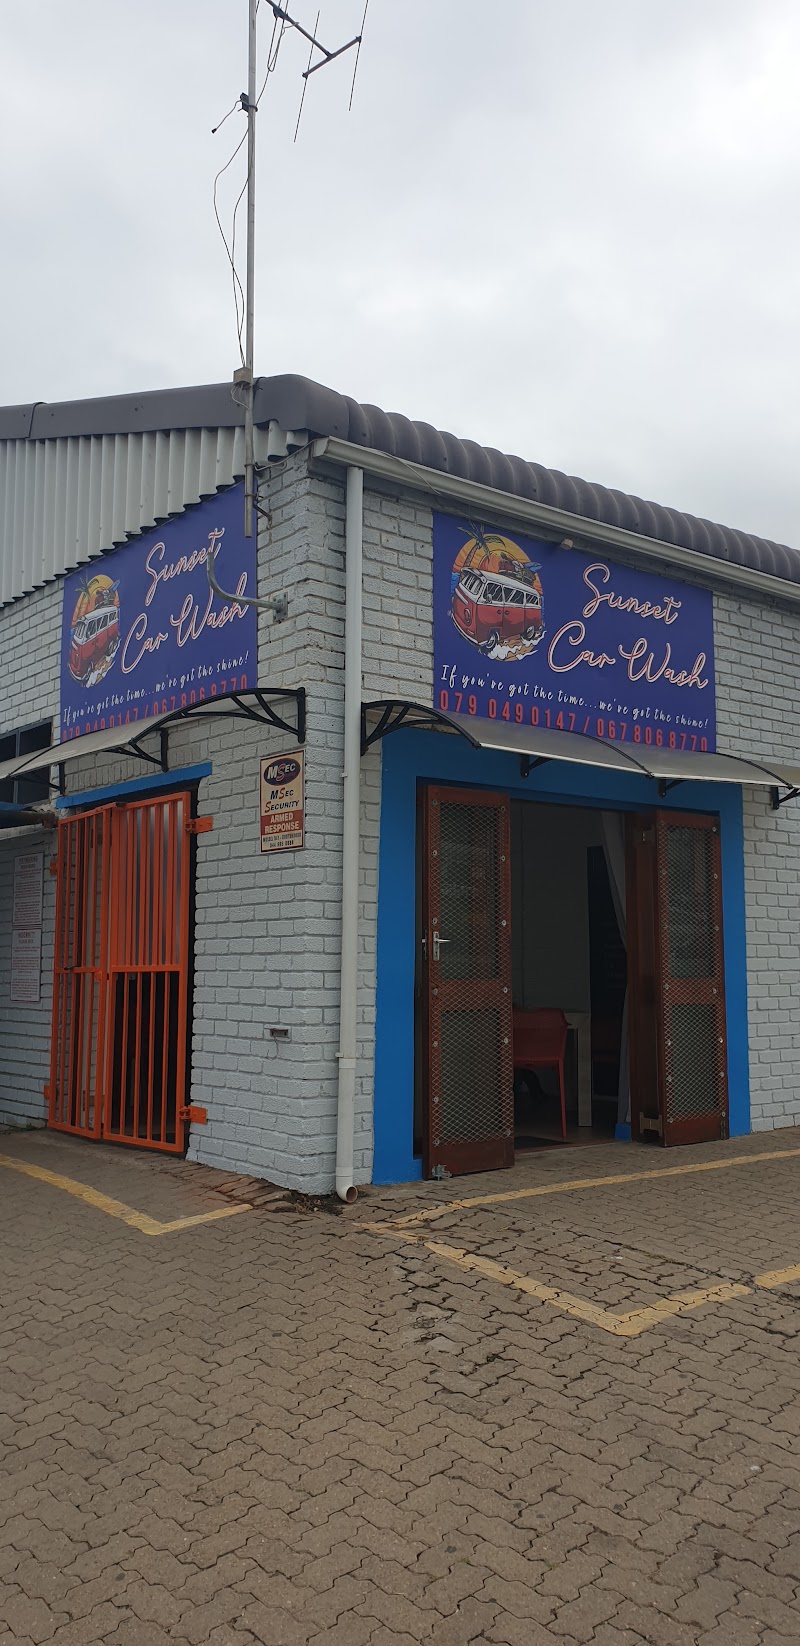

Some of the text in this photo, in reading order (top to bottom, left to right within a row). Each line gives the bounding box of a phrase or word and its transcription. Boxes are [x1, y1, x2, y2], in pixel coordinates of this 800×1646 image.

[145, 527, 225, 607] Sunset
[582, 563, 682, 624] Sunset
[121, 571, 248, 674] Car Wash
[547, 620, 708, 689] Car Wash
[63, 706, 71, 726] If
[72, 701, 94, 723] you've
[97, 696, 109, 715] got
[112, 694, 124, 706] the
[180, 668, 195, 689] got
[198, 665, 213, 679] the
[216, 650, 249, 673] shine!
[144, 704, 149, 719] /
[153, 696, 176, 717] 067
[441, 664, 457, 688] If
[462, 673, 504, 691] you've
[508, 682, 529, 697] got
[533, 684, 554, 700] the
[632, 706, 650, 720] got
[654, 708, 671, 722] the
[675, 714, 708, 729] shine!
[440, 690, 708, 752] 079 049 0147 / 067 806 8770
[264, 820, 300, 834] RESPONSE
[270, 812, 294, 824] ARMED
